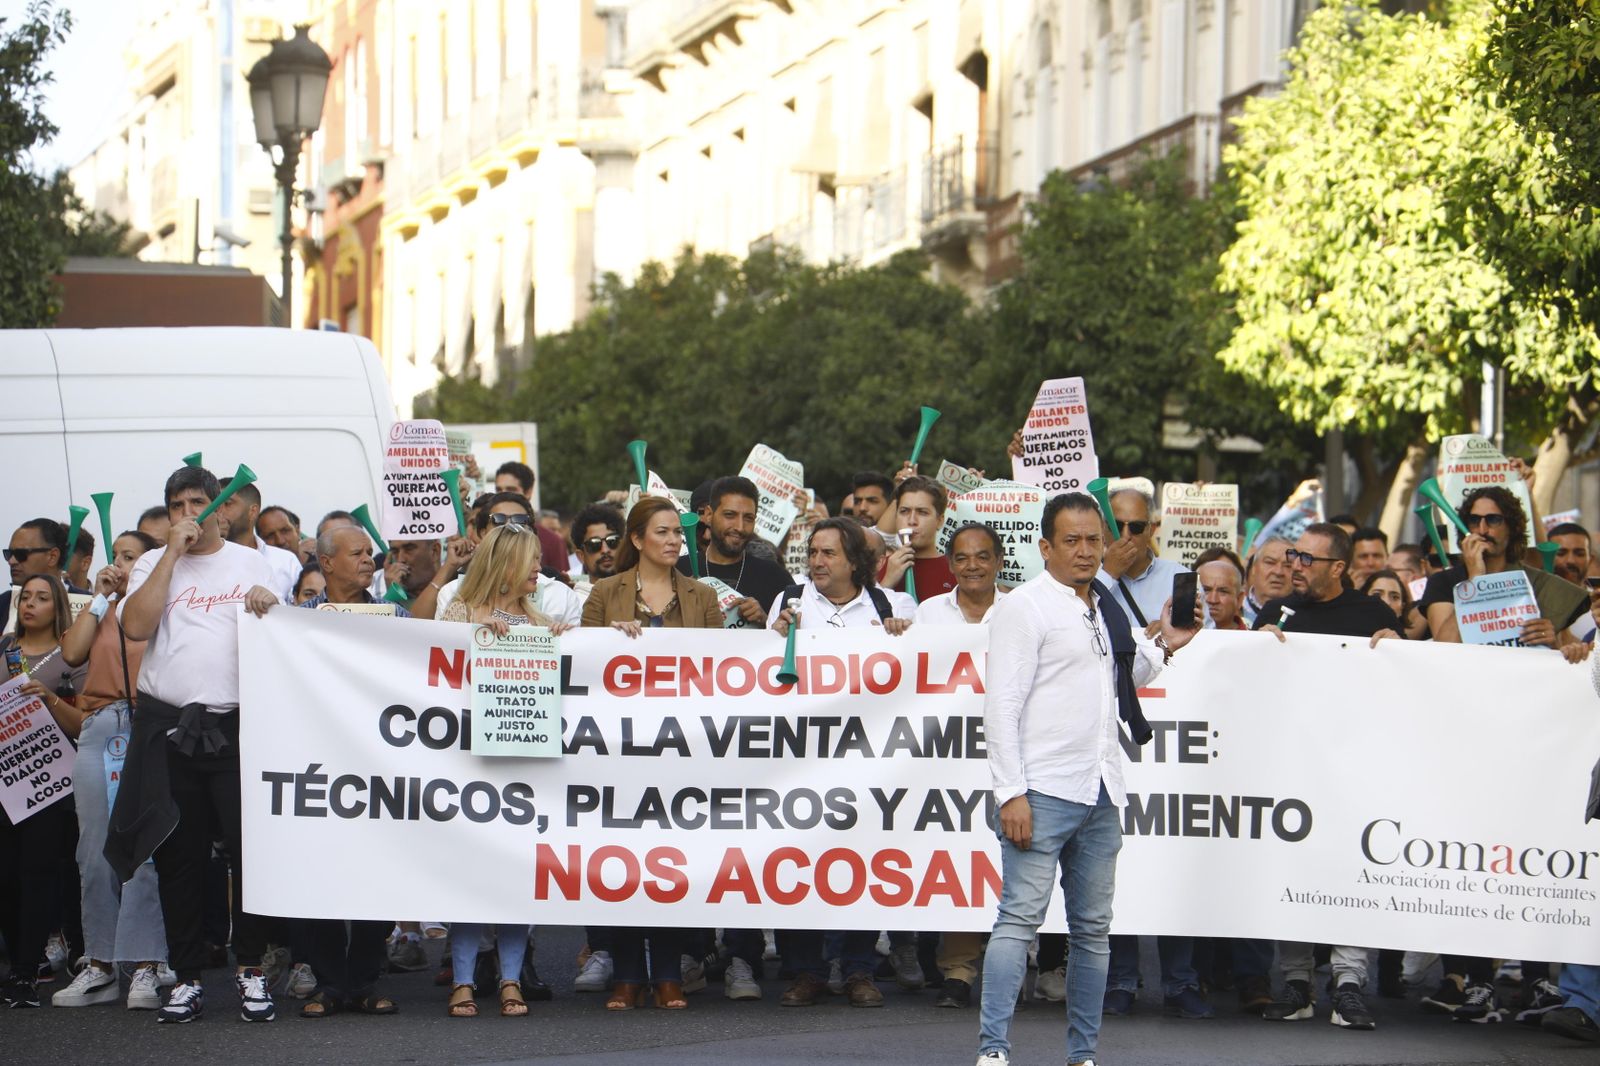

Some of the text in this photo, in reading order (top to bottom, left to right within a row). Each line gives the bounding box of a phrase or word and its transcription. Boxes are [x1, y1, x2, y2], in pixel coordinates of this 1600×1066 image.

[1029, 417, 1070, 428] UNIDOS
[400, 458, 441, 468] UNIDOS
[1023, 452, 1082, 467] DIÁLOGO
[384, 473, 442, 481] AYUNTAMIEN
[1045, 467, 1064, 478] NO
[747, 463, 805, 495] AMBULANTE
[1464, 474, 1505, 483] UNIDOS
[387, 482, 448, 496] QUEREMO
[1036, 479, 1079, 491] COSO
[393, 493, 451, 507] DIÁLOGO
[957, 492, 1039, 503] AMBULANTES
[975, 504, 1020, 513] UNIDOS
[1166, 507, 1236, 516] AMBULANTES
[412, 510, 431, 520] NO
[1181, 518, 1219, 526] UNIDOS
[399, 523, 445, 534] ACOSO
[1020, 534, 1032, 544] NI
[1173, 530, 1228, 539] PLACEROS
[1182, 552, 1198, 560] NO
[167, 584, 248, 617] Acapulc
[475, 658, 558, 670] AMBULANTES
[427, 646, 471, 690] N
[603, 652, 902, 697] GENOCIDIO
[494, 670, 540, 681] UNIDOS
[478, 684, 554, 695] EXIGIMOS UN
[496, 697, 536, 706] TRATO
[0, 700, 42, 730] LANTES
[484, 709, 548, 719] MUNICIPAL
[497, 721, 535, 730] JUSTO
[484, 733, 549, 743] Y HUMANO
[621, 716, 692, 757] LA
[700, 716, 875, 758] VENTA
[2, 748, 63, 787] DIÁLOGO
[30, 771, 51, 789] NO
[26, 776, 72, 810] ACOSO
[261, 763, 549, 834] TÉCNICOS,
[566, 784, 858, 830] PLACEROS
[869, 787, 909, 831] Y
[1361, 818, 1600, 880] Comacor
[534, 843, 1004, 907] NOS ACOSAN
[1357, 868, 1597, 902] Asociación de Comerciantes
[1280, 887, 1591, 927] Autónomos Ambulantes de Córdoba
